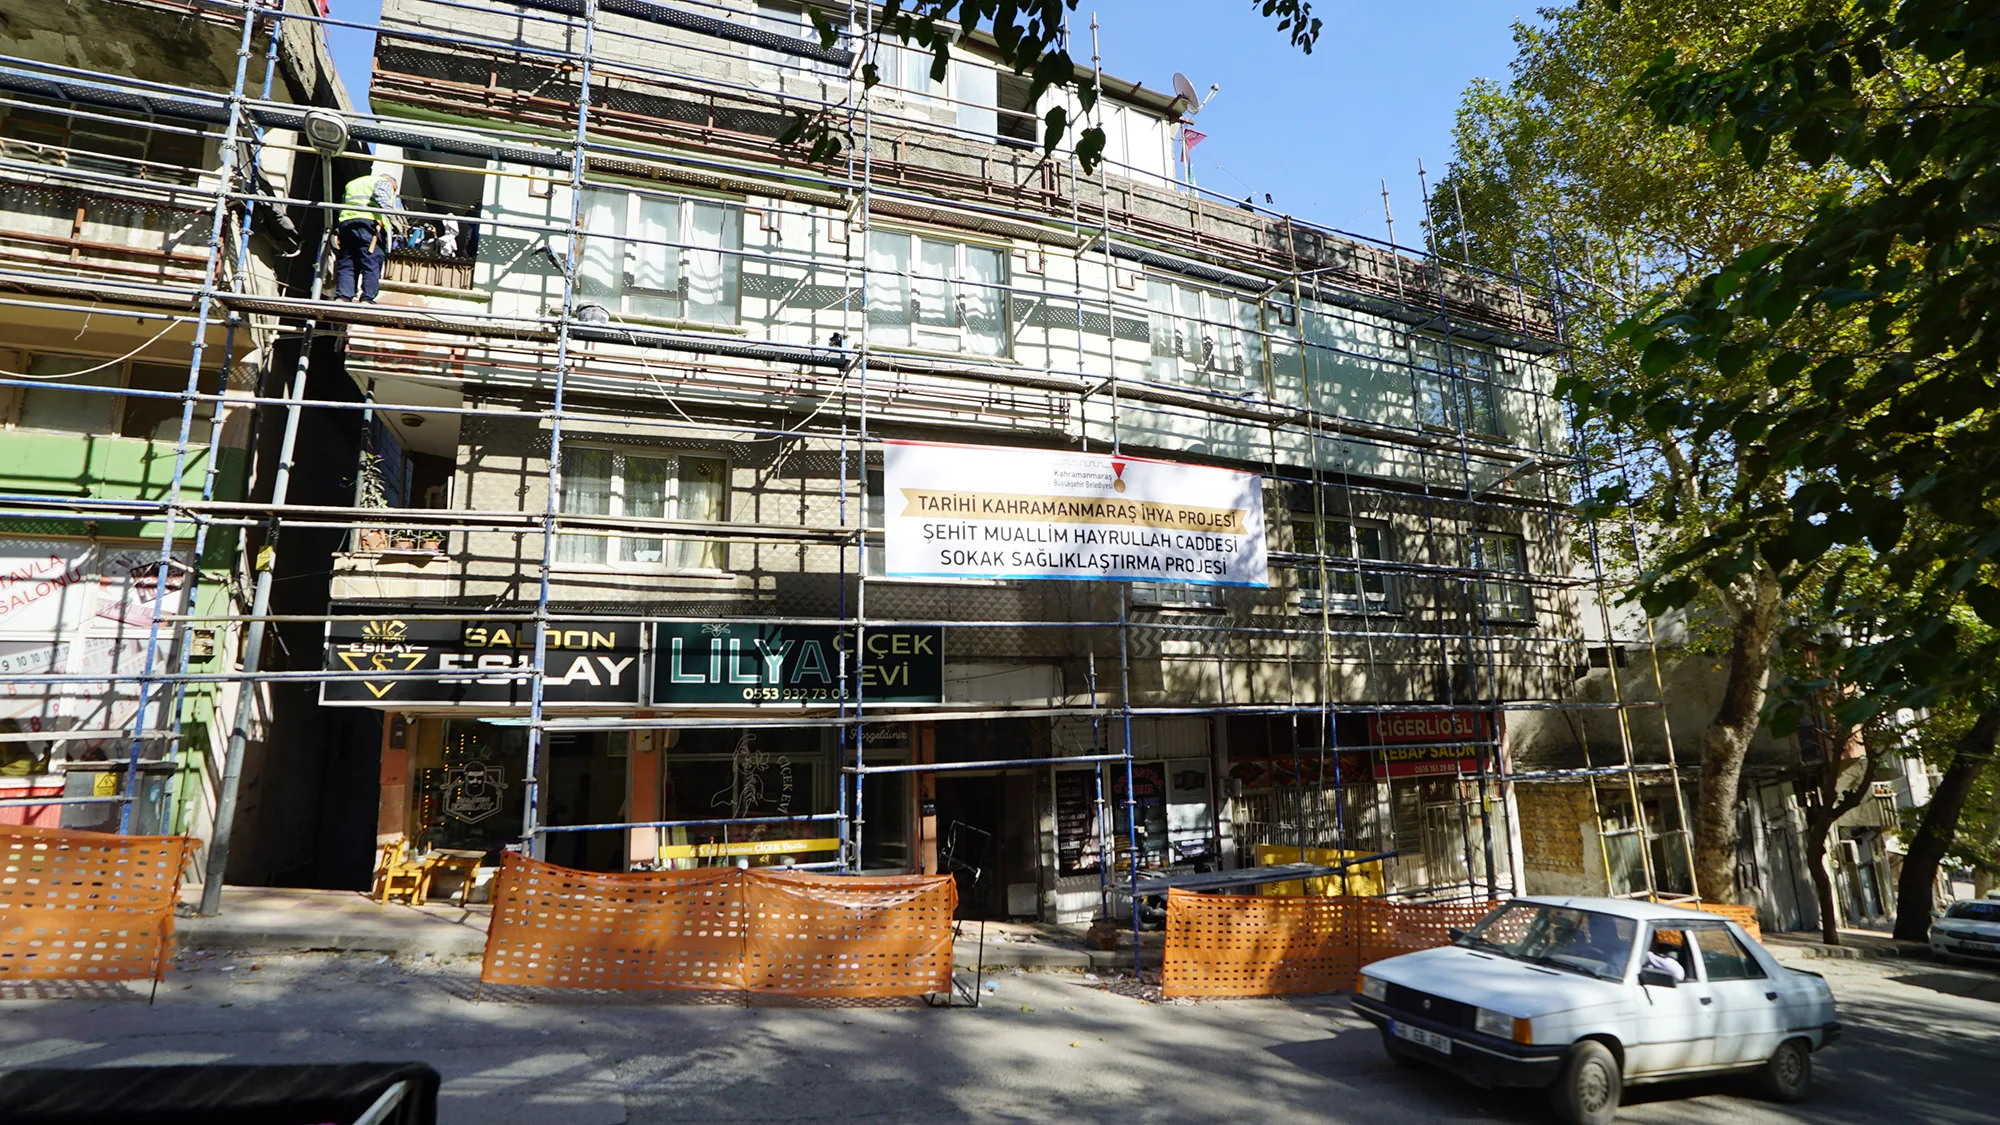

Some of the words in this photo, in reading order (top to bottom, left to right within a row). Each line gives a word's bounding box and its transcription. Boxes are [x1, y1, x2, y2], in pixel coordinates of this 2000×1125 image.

[1054, 470, 1113, 482] Kahramanmaraş
[918, 494, 976, 512] TARİHİ
[982, 499, 1137, 523] KAHRAMANMARAŞ
[1141, 504, 1175, 523] İHYA
[1178, 511, 1236, 528] PROJESİ
[923, 521, 977, 543] ŞEHİT
[984, 524, 1068, 543] MUALLİM
[1074, 529, 1171, 548] HAYRULLAH
[1176, 535, 1238, 553] CADDESİ
[940, 550, 1005, 566] SOKAK
[1012, 548, 1161, 573] SAĞLIKLAŞTIRMA
[1165, 557, 1227, 575] PROJESİ
[832, 633, 935, 660] ÇÇEK
[861, 661, 909, 687] EVİ
[743, 687, 780, 700] 0553
[782, 687, 809, 700] 932
[812, 687, 828, 700] 73
[1430, 744, 1479, 758] SALON
